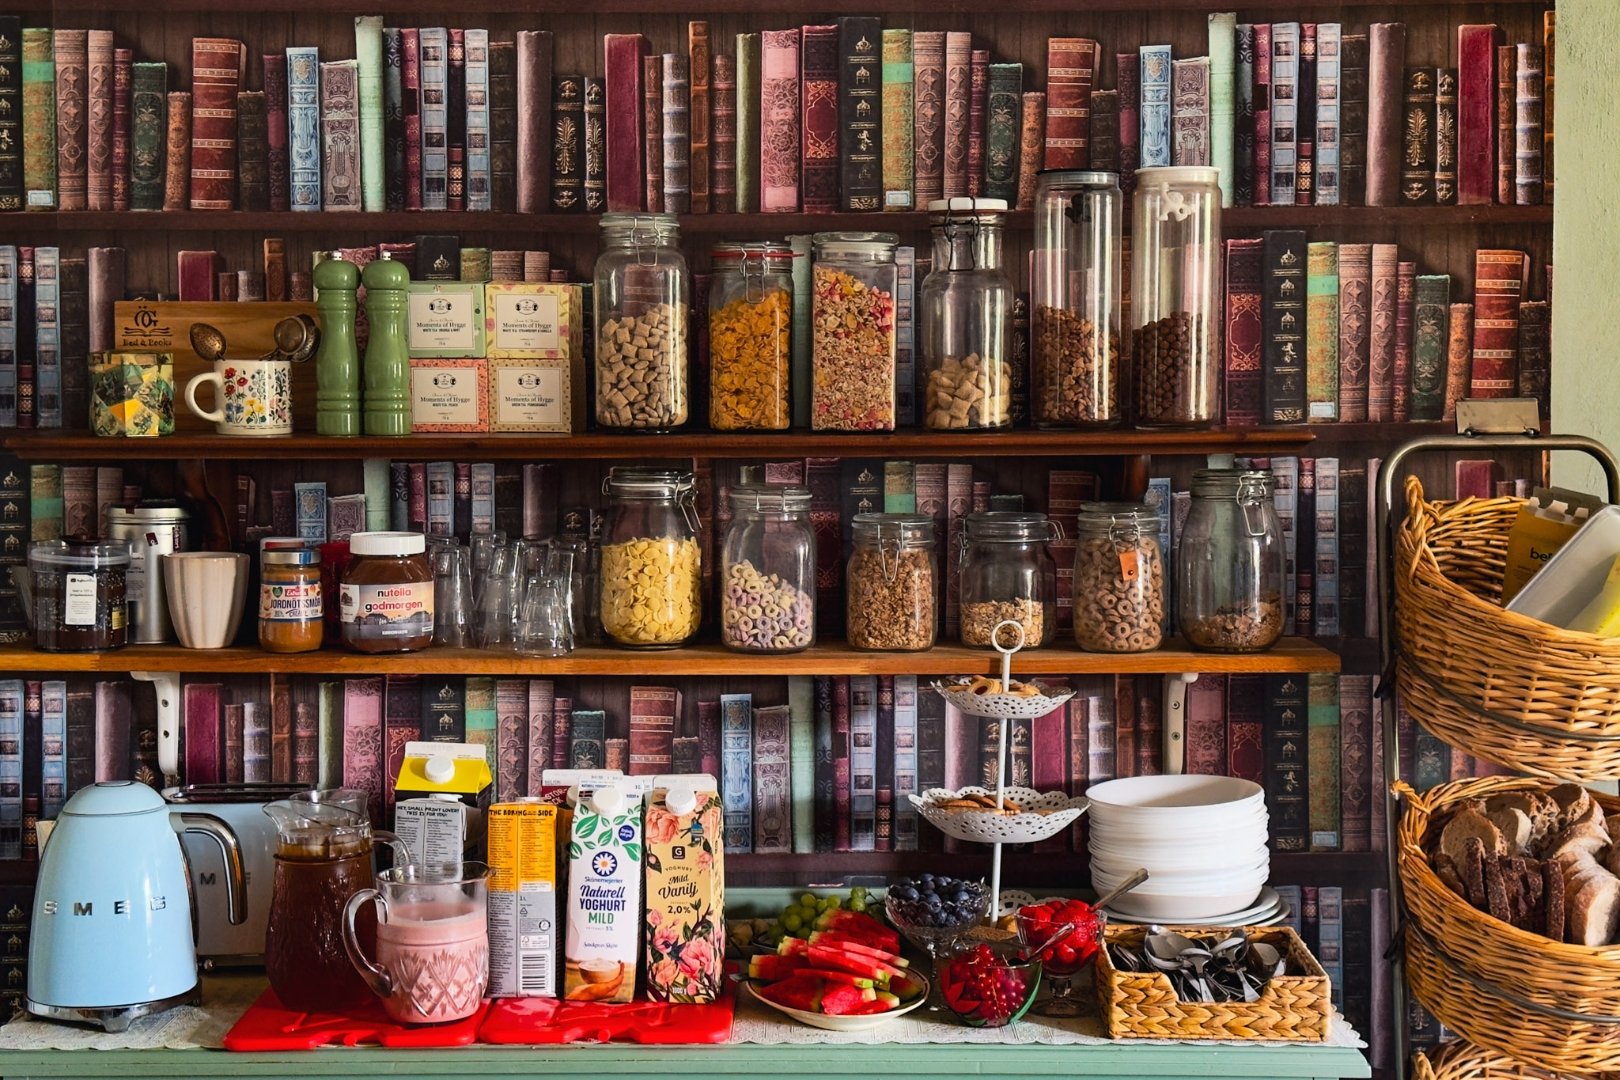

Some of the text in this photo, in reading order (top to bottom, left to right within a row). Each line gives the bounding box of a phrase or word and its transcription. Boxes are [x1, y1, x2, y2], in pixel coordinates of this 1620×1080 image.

[377, 588, 412, 597] nutella
[365, 601, 423, 613] godmorgen
[503, 809, 527, 817] BORING
[538, 809, 553, 817] SIDE
[675, 847, 683, 856] G
[668, 874, 689, 885] Mild
[580, 884, 626, 899] Naturell
[658, 881, 699, 900] Vanilj
[579, 898, 627, 912] YOGHURT
[667, 905, 691, 915] 2,0%
[588, 911, 615, 925] MILD
